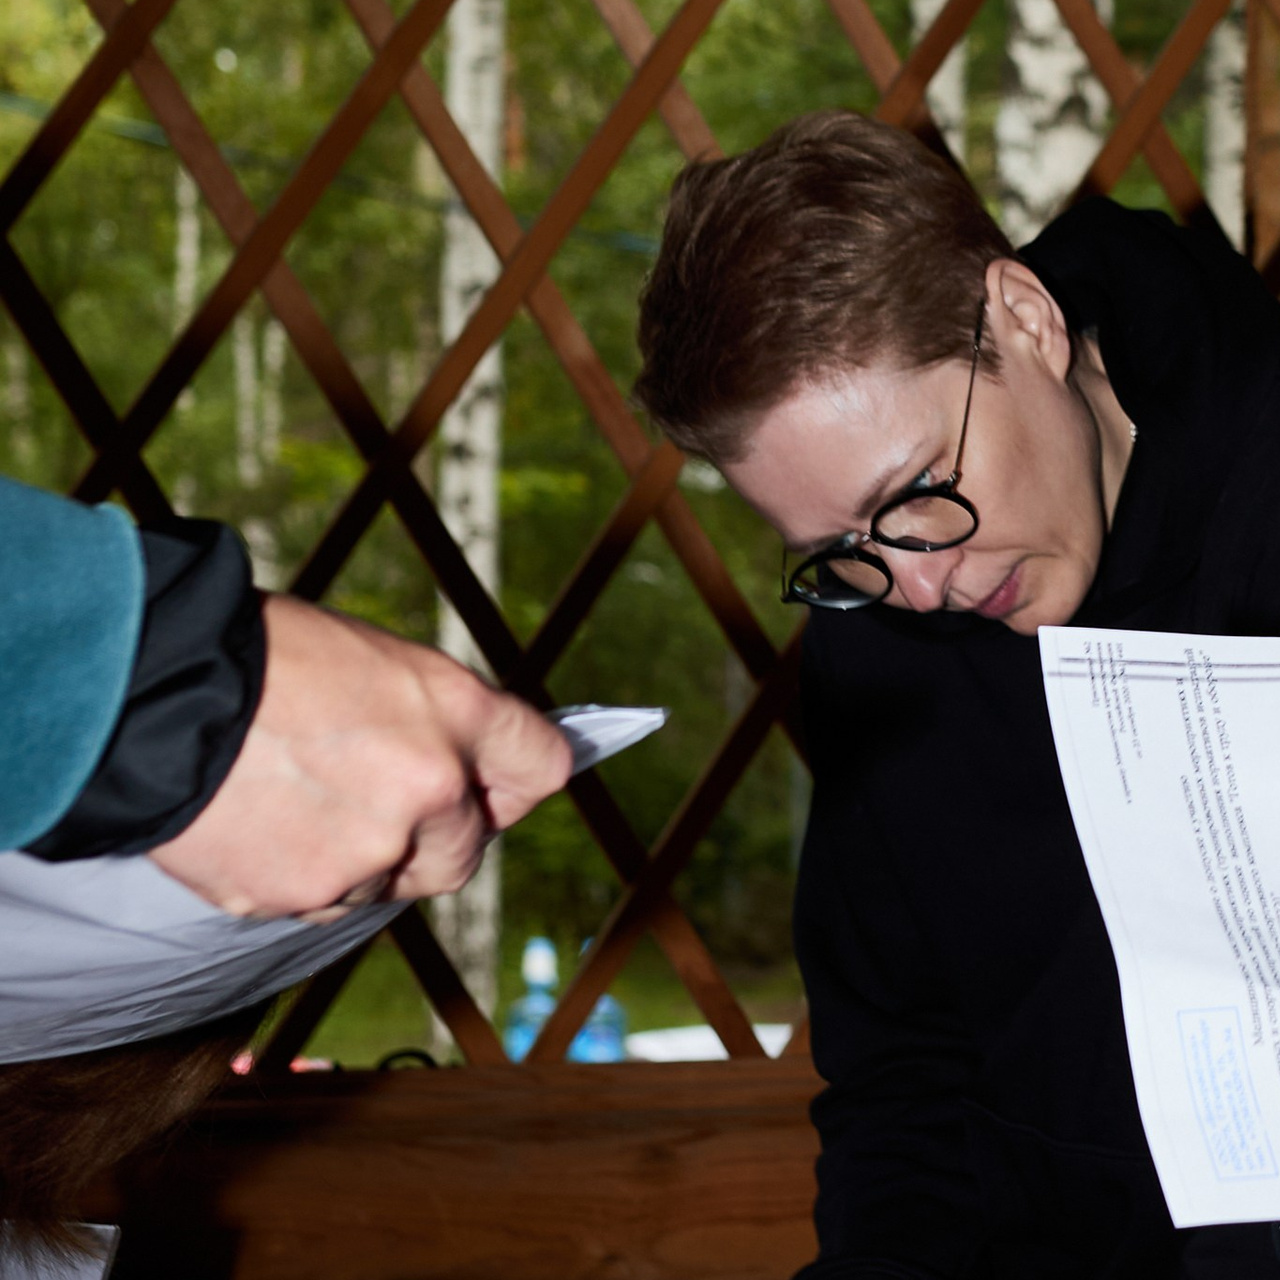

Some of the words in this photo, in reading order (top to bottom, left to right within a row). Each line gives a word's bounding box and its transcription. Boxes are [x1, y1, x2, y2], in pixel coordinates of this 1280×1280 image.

[1178, 690, 1200, 773] мероприятиях
[1198, 716, 1219, 785] нормативов
[1215, 718, 1230, 750] труду
[1179, 774, 1197, 823] участию
[1214, 789, 1238, 858] выполнения
[1195, 837, 1215, 882] допуске
[1234, 805, 1255, 865] комплекса
[1233, 865, 1251, 905] оценке
[1238, 963, 1263, 1044] Медицинское
